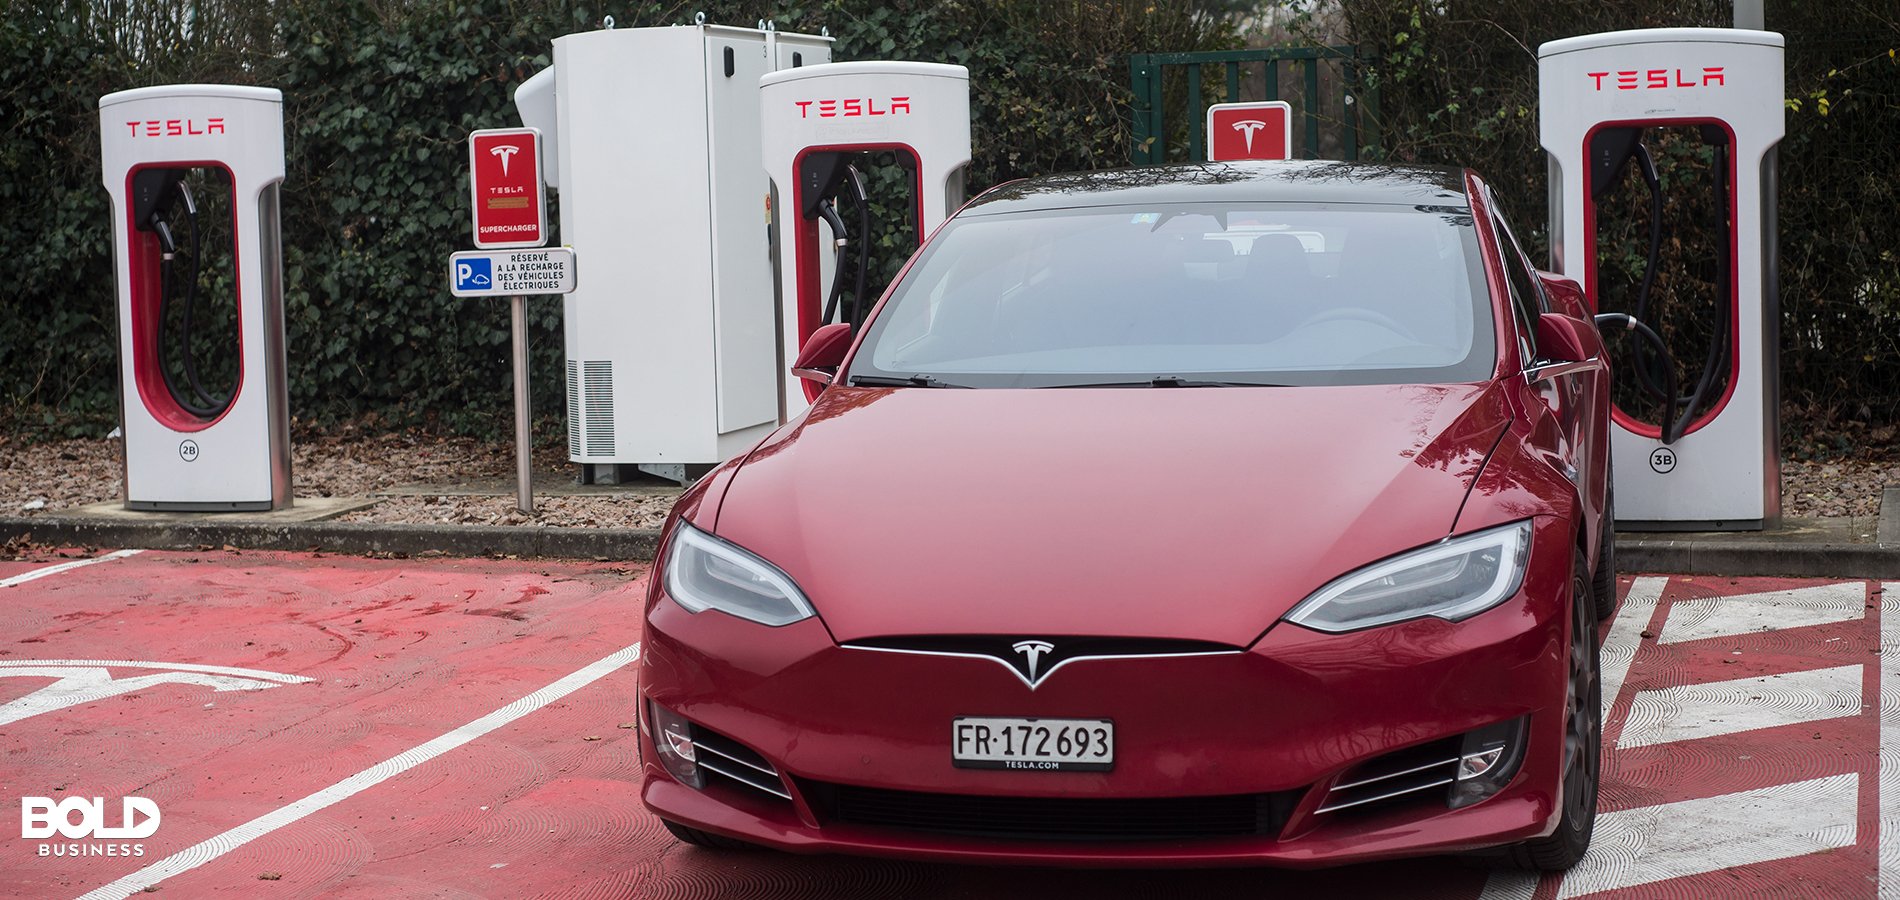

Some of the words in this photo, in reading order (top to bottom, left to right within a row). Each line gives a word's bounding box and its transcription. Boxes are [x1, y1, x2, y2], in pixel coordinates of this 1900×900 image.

[1587, 67, 1725, 91] TESLA
[795, 96, 910, 118] TESLA
[126, 118, 225, 138] TESLA
[490, 186, 524, 194] TESLA
[480, 224, 537, 233] SUPERCHARGER
[511, 252, 549, 262] RÉSERVÉ
[497, 264, 503, 272] A
[506, 264, 517, 272] LA
[520, 262, 564, 271] RECHARGE
[497, 273, 514, 281] DES
[518, 271, 564, 280] VÉHICULES
[503, 280, 560, 290] ÉLECTRIQUES
[183, 445, 196, 455] 2B
[1655, 455, 1672, 465] 3B
[1005, 761, 1059, 770] TESLA.COM
